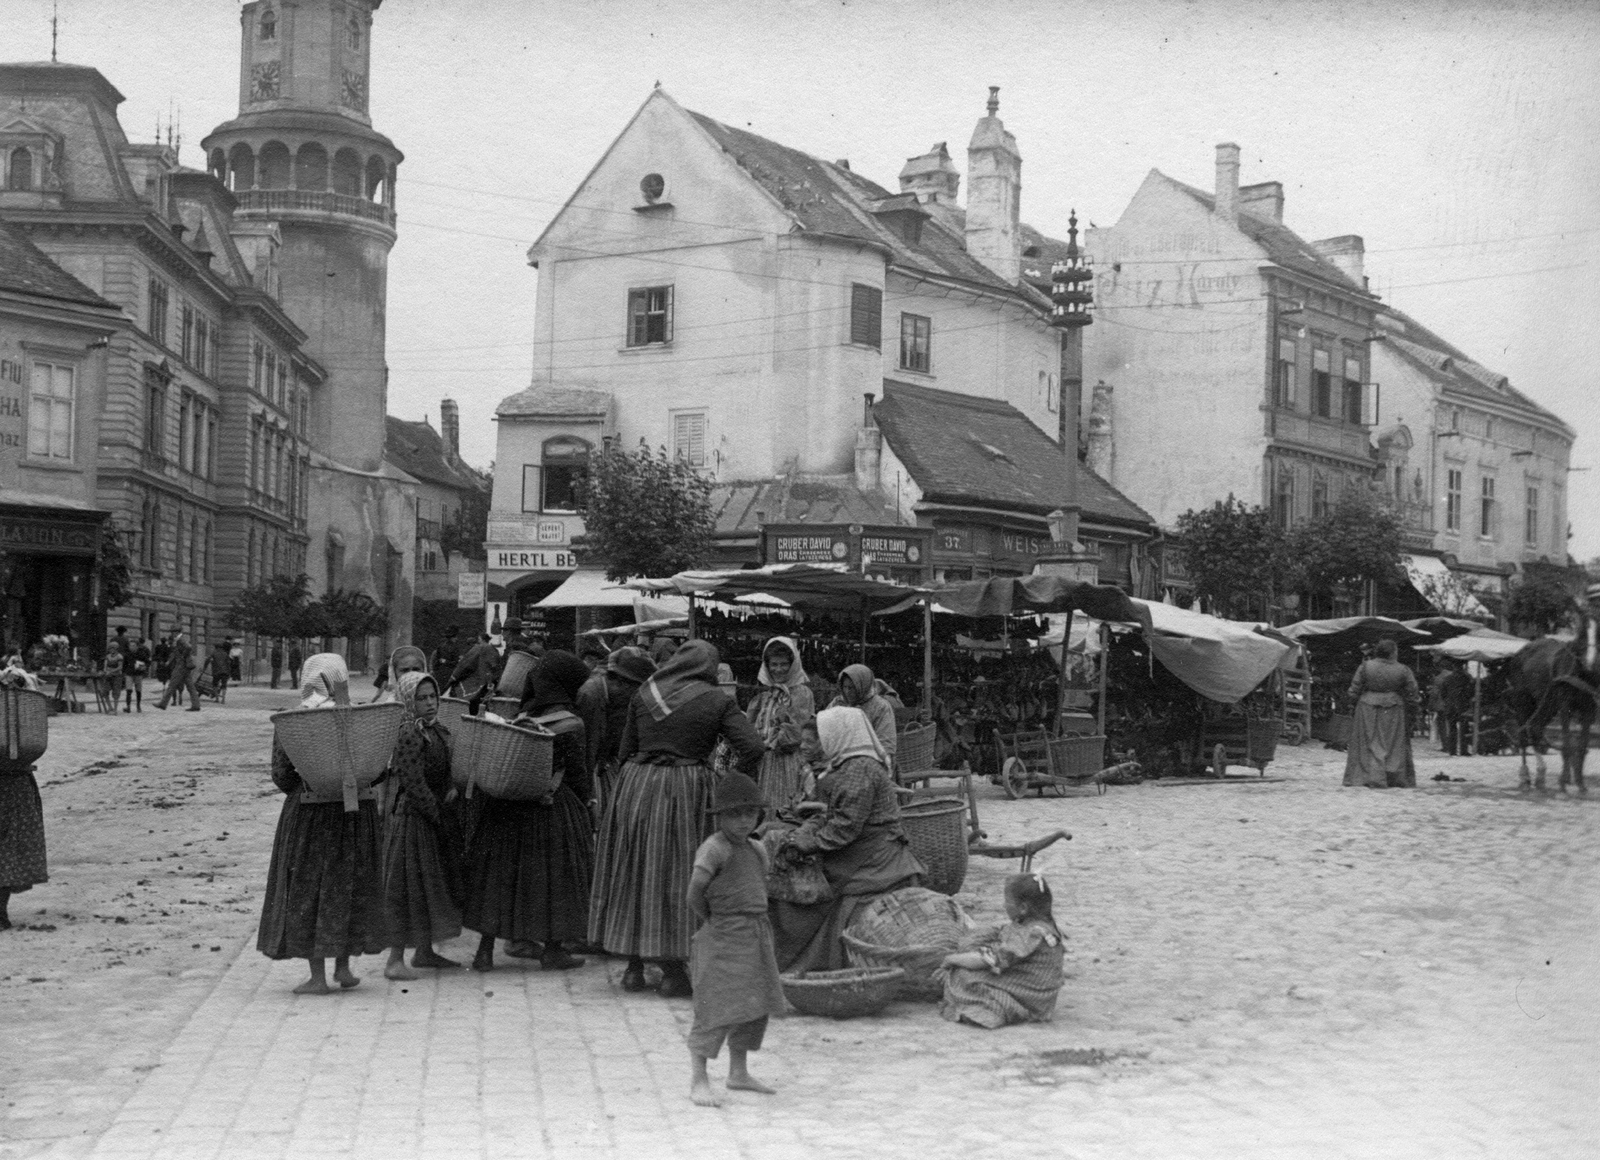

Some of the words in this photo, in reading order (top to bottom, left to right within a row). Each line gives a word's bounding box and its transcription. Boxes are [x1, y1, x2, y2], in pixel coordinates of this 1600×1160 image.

[778, 537, 808, 550] GRUBER
[809, 537, 831, 550] DAVID
[861, 537, 888, 551] GRUBER
[888, 538, 907, 553] DAVID
[499, 553, 549, 567] HERTL
[861, 550, 876, 562] OAS
